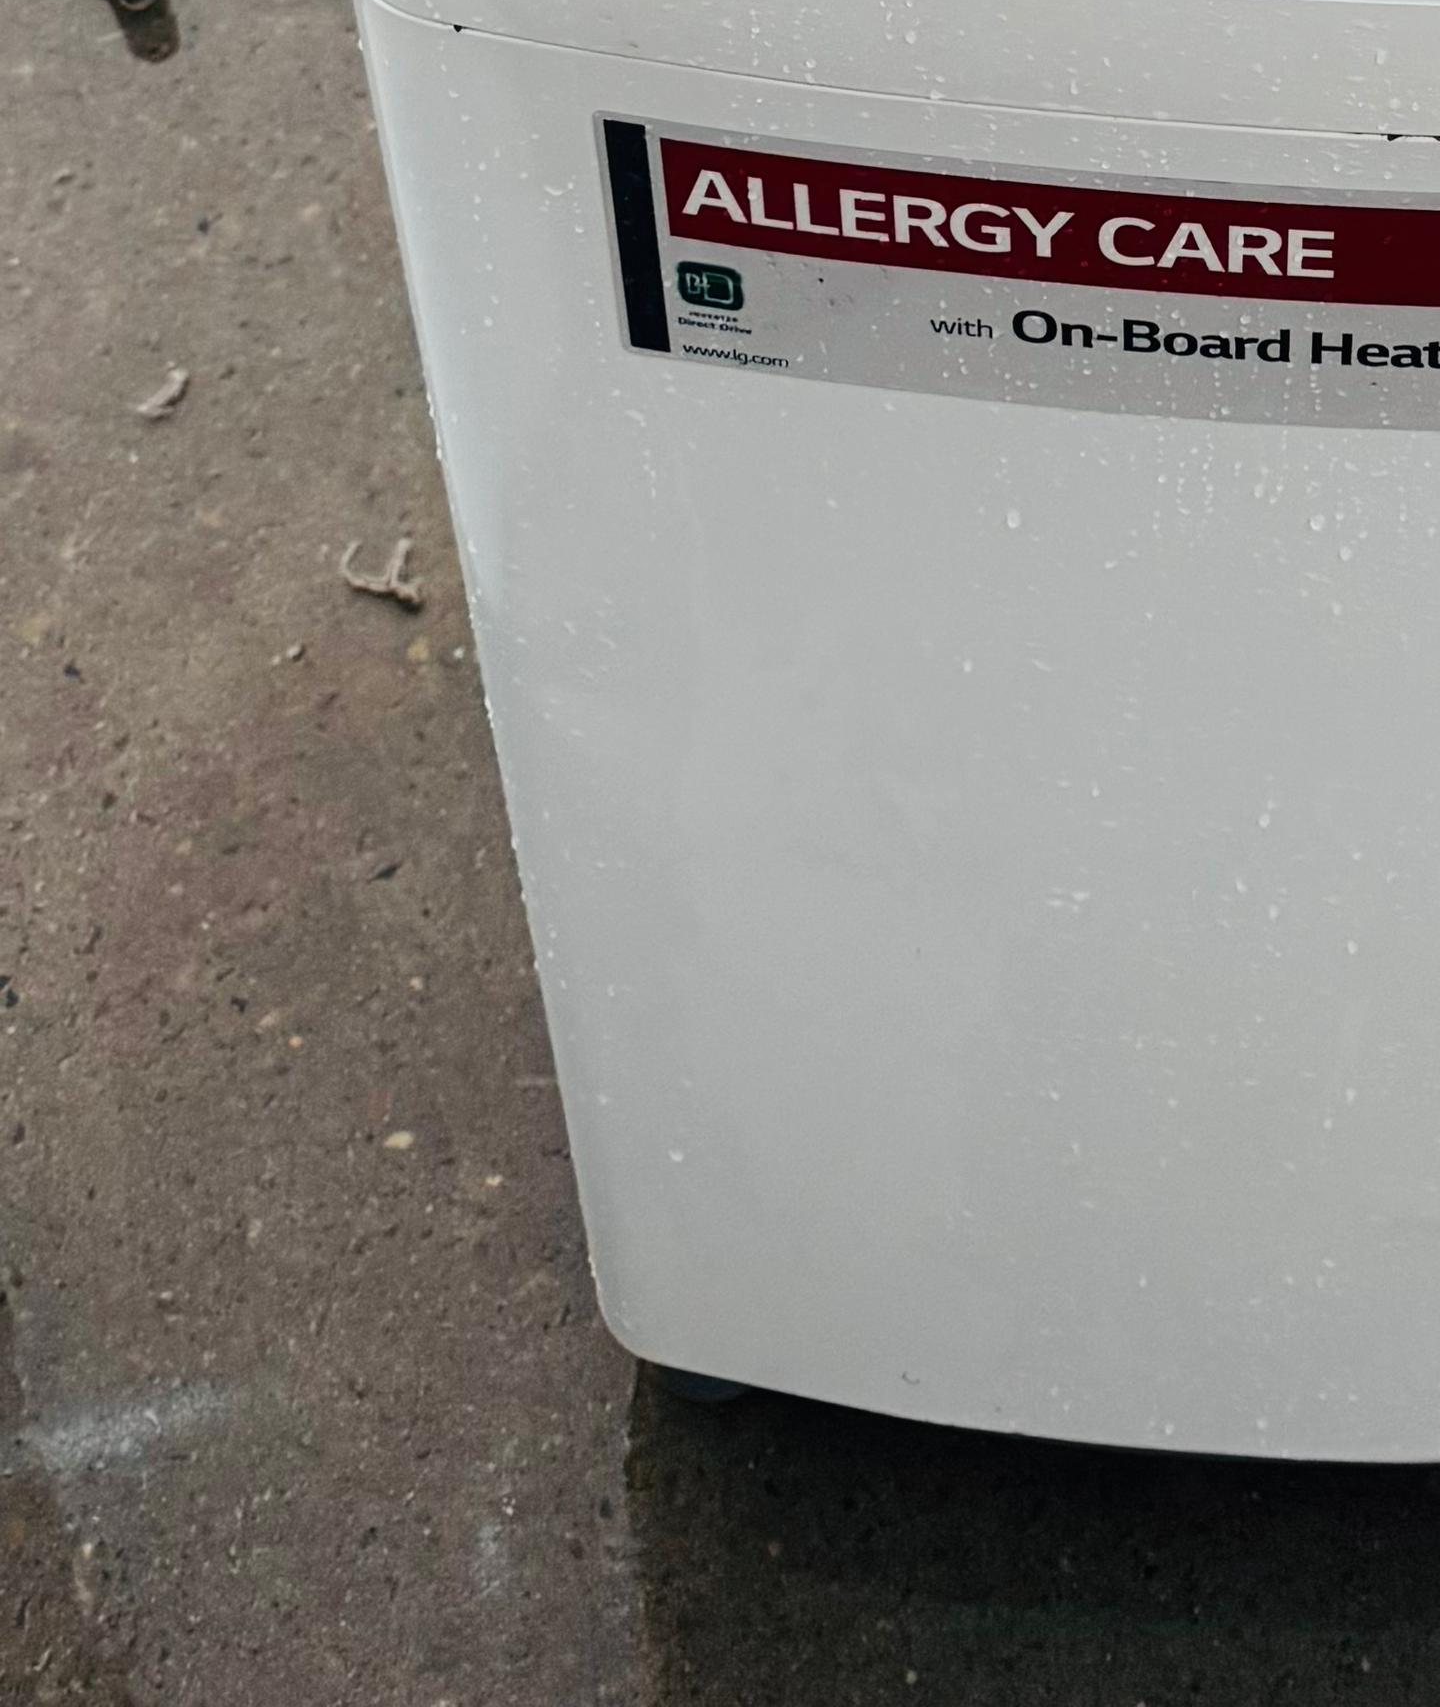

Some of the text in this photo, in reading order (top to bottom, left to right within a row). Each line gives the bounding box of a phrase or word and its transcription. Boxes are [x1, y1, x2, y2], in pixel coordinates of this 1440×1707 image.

[681, 169, 1335, 278] ALLERGY CARE
[678, 316, 715, 330] Direct
[719, 322, 752, 336] Drive
[930, 316, 994, 340] with
[1012, 310, 1292, 363] On-Board
[682, 343, 790, 368] www.lg.com
